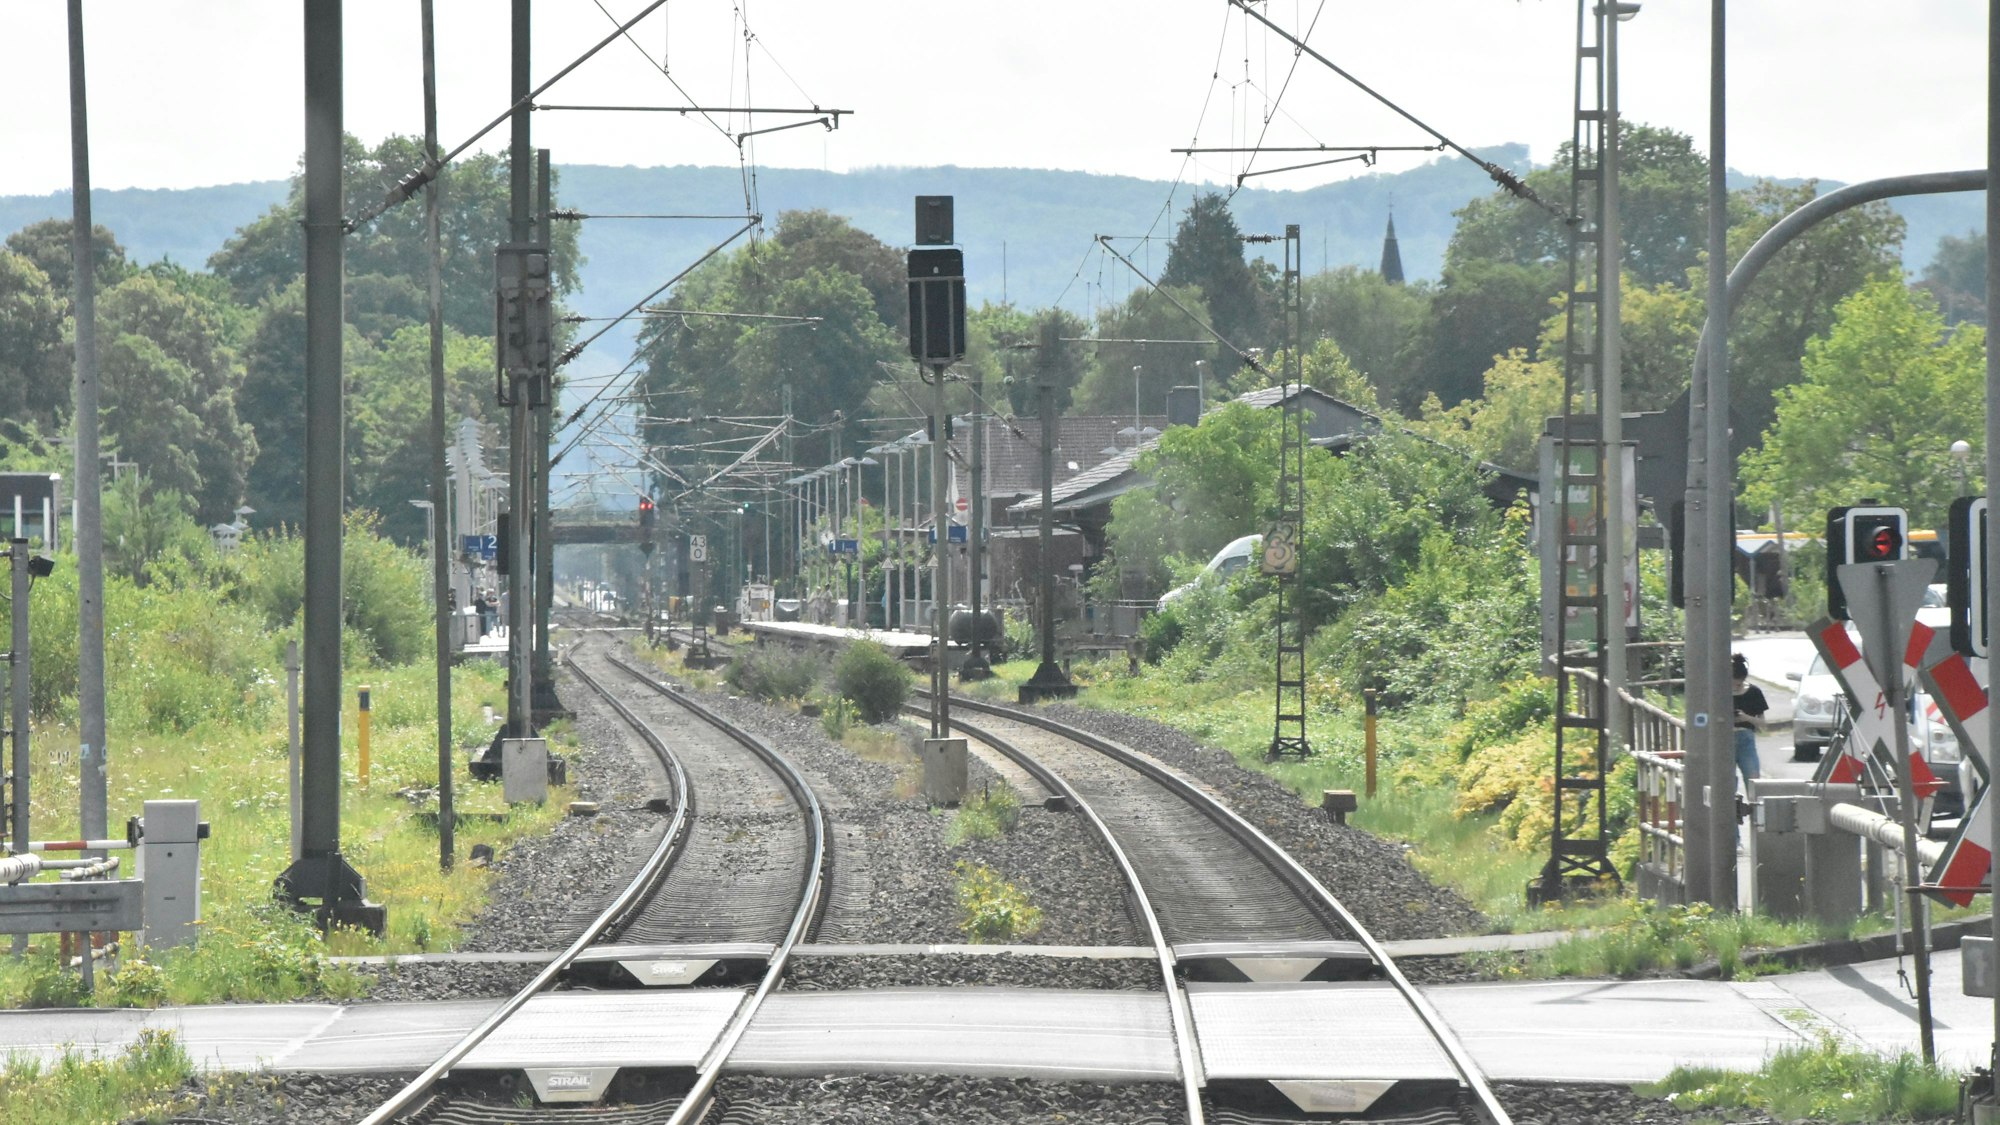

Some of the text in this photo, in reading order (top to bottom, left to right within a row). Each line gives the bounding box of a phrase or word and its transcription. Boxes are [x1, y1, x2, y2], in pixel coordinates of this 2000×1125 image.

[488, 535, 497, 549] 2
[691, 536, 706, 548] 43
[693, 548, 702, 559] 0
[548, 1076, 590, 1087] STRAIL
